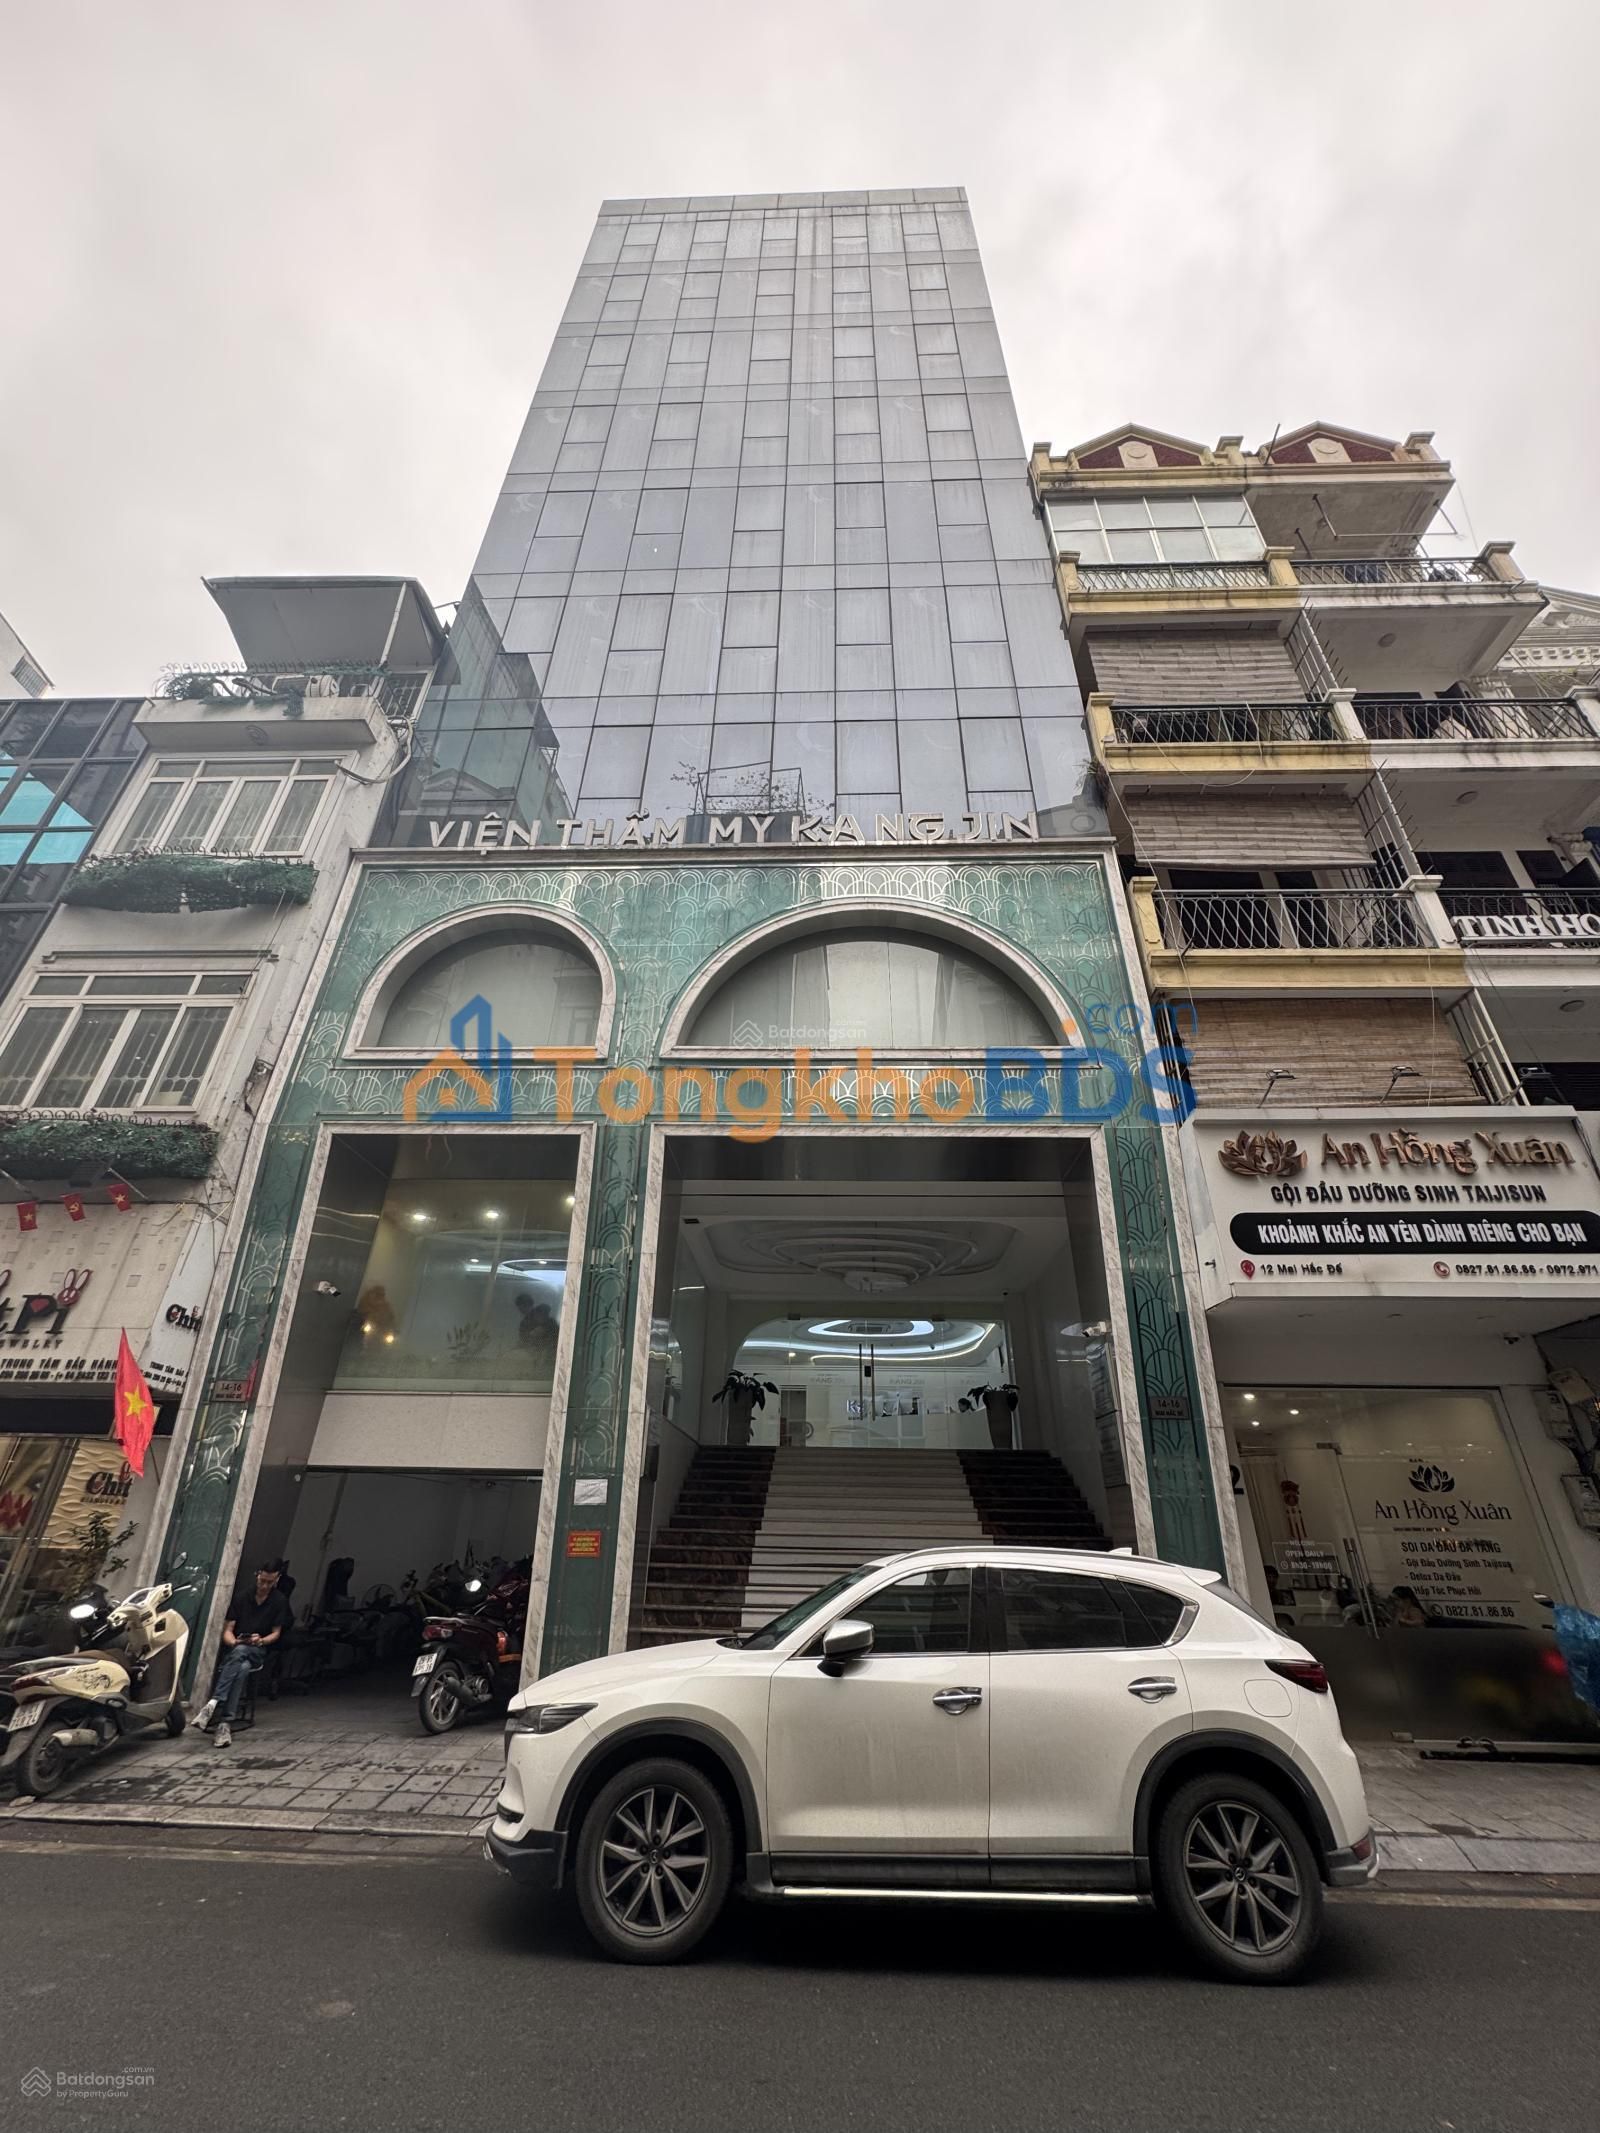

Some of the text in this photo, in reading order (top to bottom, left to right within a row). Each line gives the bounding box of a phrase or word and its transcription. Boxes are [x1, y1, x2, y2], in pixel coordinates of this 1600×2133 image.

[429, 812, 542, 856] VIỆN
[556, 807, 687, 849] THẨM
[792, 812, 945, 844] KANG
[957, 811, 1038, 843] JIN
[1320, 1127, 1576, 1175] An Hồng Xuân
[1271, 1181, 1548, 1206] GỘI ĐẦU DƯỠNG SINH TAIJISUN
[1257, 1217, 1588, 1247] KHOẢNH KHẮC AN YÊN DÀNH RIÊNG CHO BẠN
[1260, 1264, 1275, 1275] 12
[1375, 1498, 1513, 1526] An Hồng Xuân
